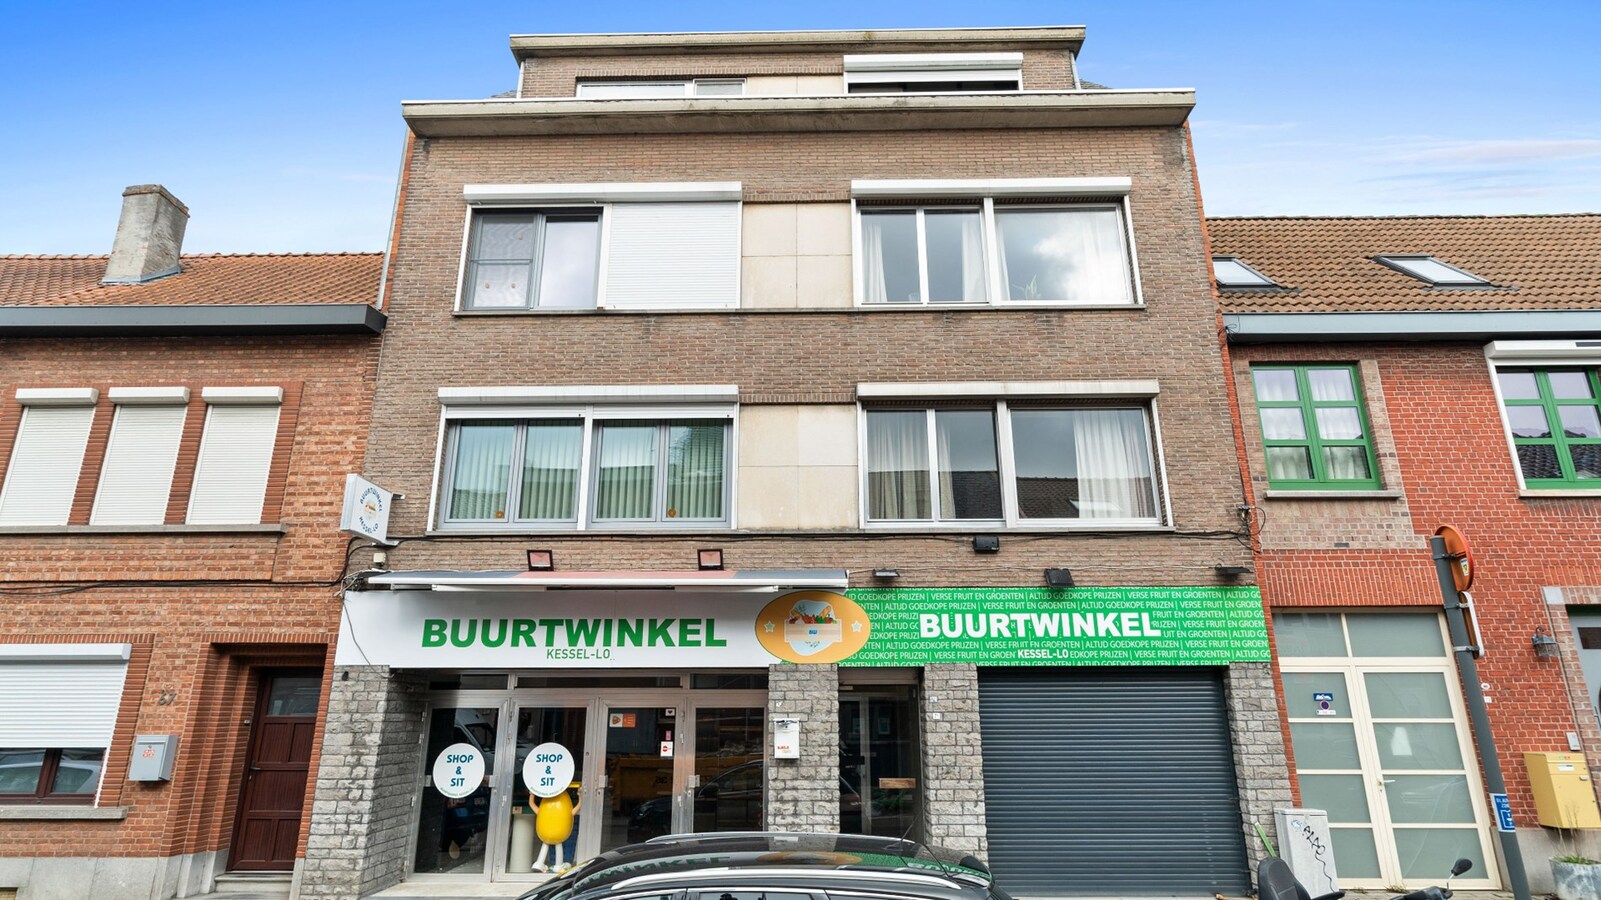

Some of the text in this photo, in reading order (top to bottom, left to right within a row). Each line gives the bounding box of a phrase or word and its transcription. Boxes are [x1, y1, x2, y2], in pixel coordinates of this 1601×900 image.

[856, 593, 896, 601] GOEDKOPE
[897, 593, 926, 601] PRIJZEN
[930, 592, 952, 600] VERSE
[953, 592, 974, 600] FRUIT
[974, 592, 984, 600] EN
[986, 592, 1024, 600] GROENTEN
[1028, 592, 1052, 600] ALTIJD
[1053, 592, 1092, 600] GOEDKOPE
[1093, 592, 1120, 600] PRIJZEN
[1128, 591, 1149, 599] VERSE
[1150, 591, 1170, 599] FRUIT
[1171, 591, 1182, 599] EN
[1182, 591, 1220, 599] GROENTEN
[1226, 591, 1250, 599] ALTIJD
[920, 612, 1162, 638] BUURTWINKEL
[422, 618, 727, 648] BUURTWINKEL
[546, 648, 610, 660] KESSEL-LO
[1018, 649, 1068, 658] KESSEL-LO
[447, 754, 474, 763] SHOP
[536, 754, 563, 762] SHOP
[456, 766, 462, 774] &
[545, 766, 551, 774] &
[450, 778, 465, 786] SIT
[540, 778, 555, 786] SIT
